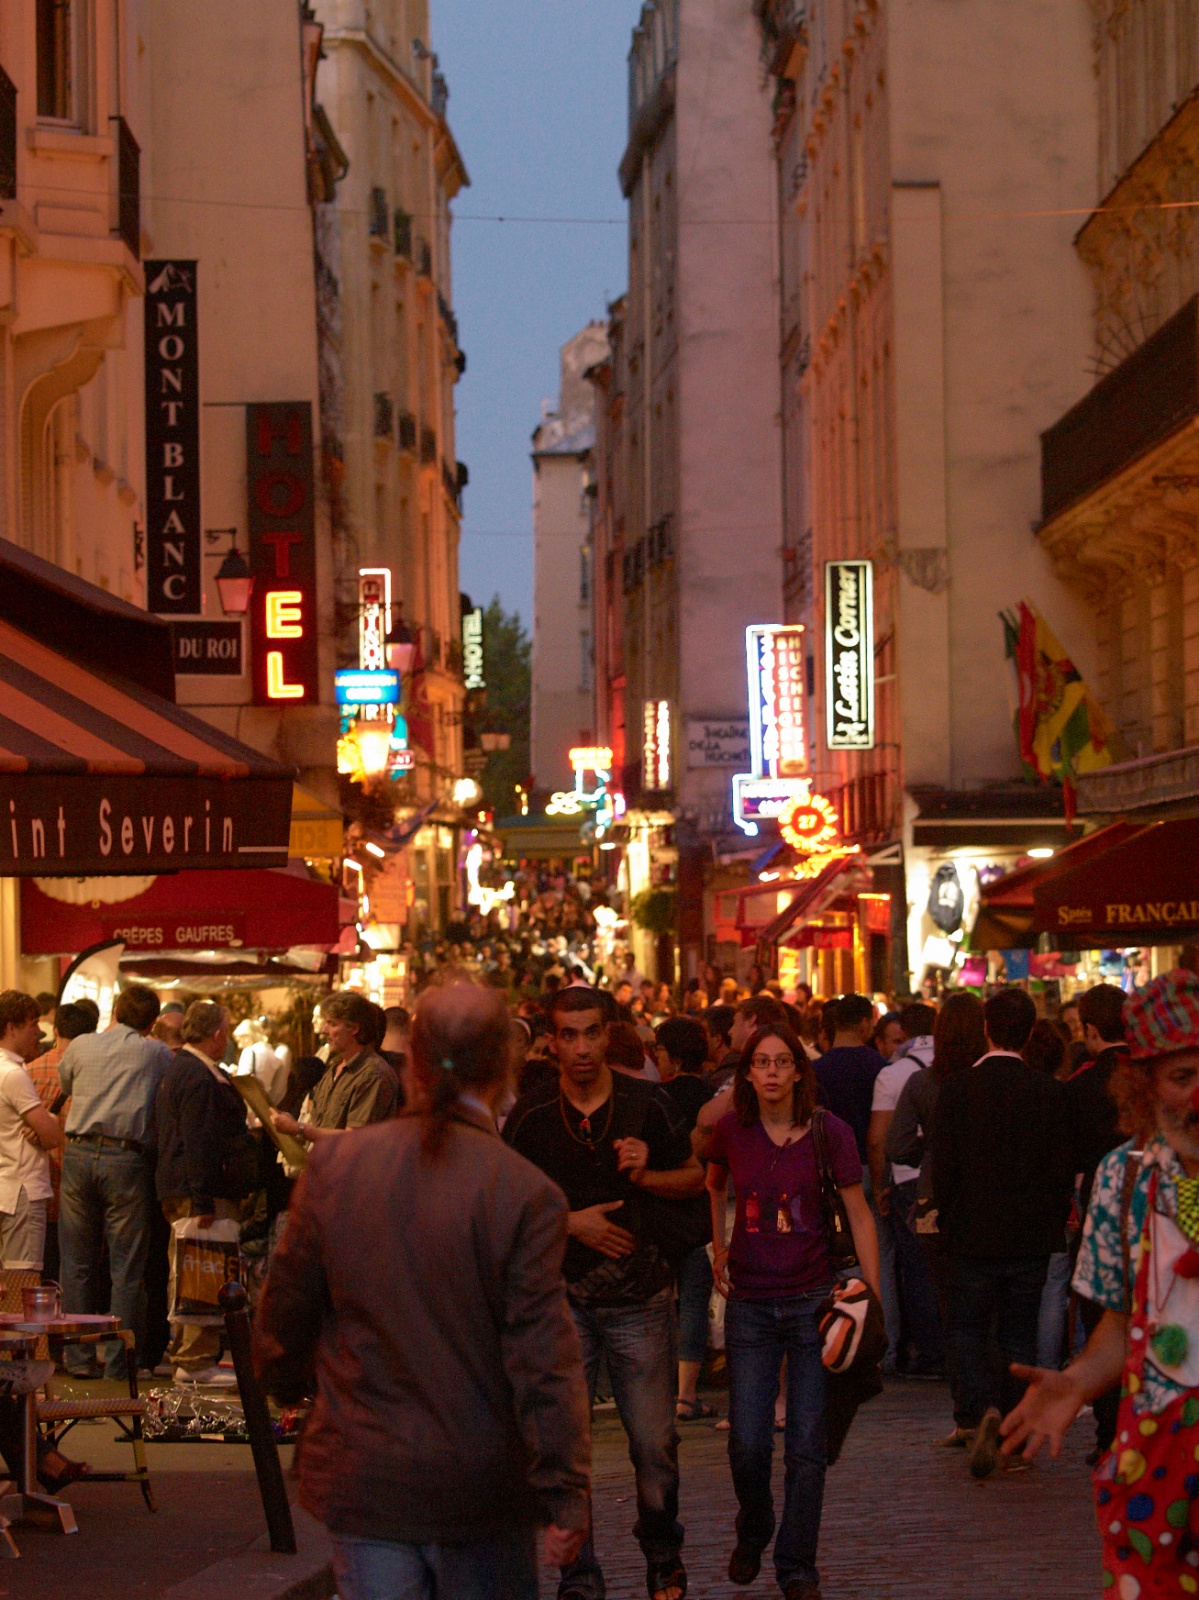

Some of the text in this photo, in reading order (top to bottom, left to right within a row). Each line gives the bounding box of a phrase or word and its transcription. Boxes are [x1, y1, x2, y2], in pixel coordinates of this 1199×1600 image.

[156, 301, 188, 601] MONT BLANC
[254, 408, 305, 698] HOTEL
[179, 637, 238, 659] DU ROI
[463, 607, 483, 676] HOTEL
[833, 565, 860, 722] Latin Corner
[99, 798, 233, 857] Severin
[797, 813, 818, 830] 27
[175, 925, 235, 943] GAUFRES
[1105, 899, 1199, 927] FRANÇAI
